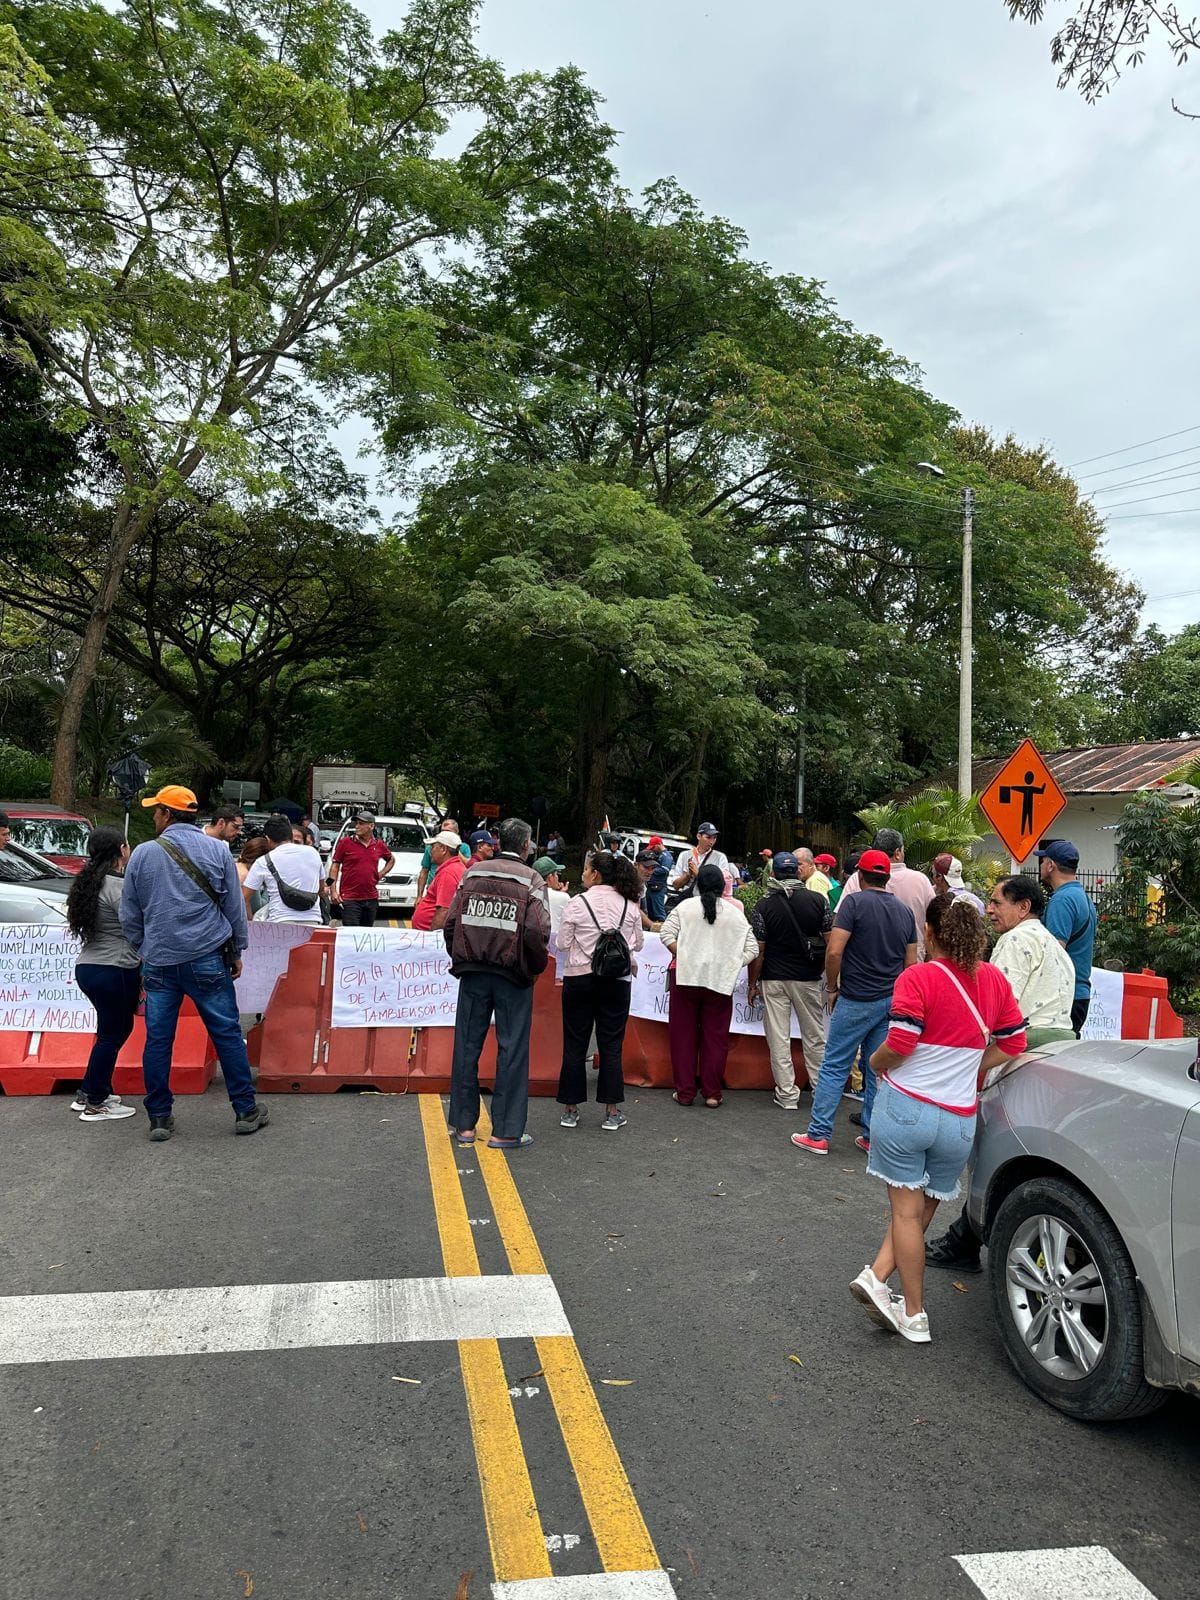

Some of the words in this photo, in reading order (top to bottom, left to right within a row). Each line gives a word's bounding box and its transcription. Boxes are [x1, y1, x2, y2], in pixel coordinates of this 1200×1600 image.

[353, 932, 386, 952] VAN
[17, 958, 35, 970] QUE
[39, 957, 50, 970] LA
[371, 962, 384, 981] LA
[4, 972, 16, 984] SE
[21, 970, 73, 984] RESPETE!
[348, 992, 366, 1005] DE
[373, 985, 391, 1003] LA
[397, 981, 454, 1000] LICENCIA
[1089, 1002, 1104, 1016] LOS
